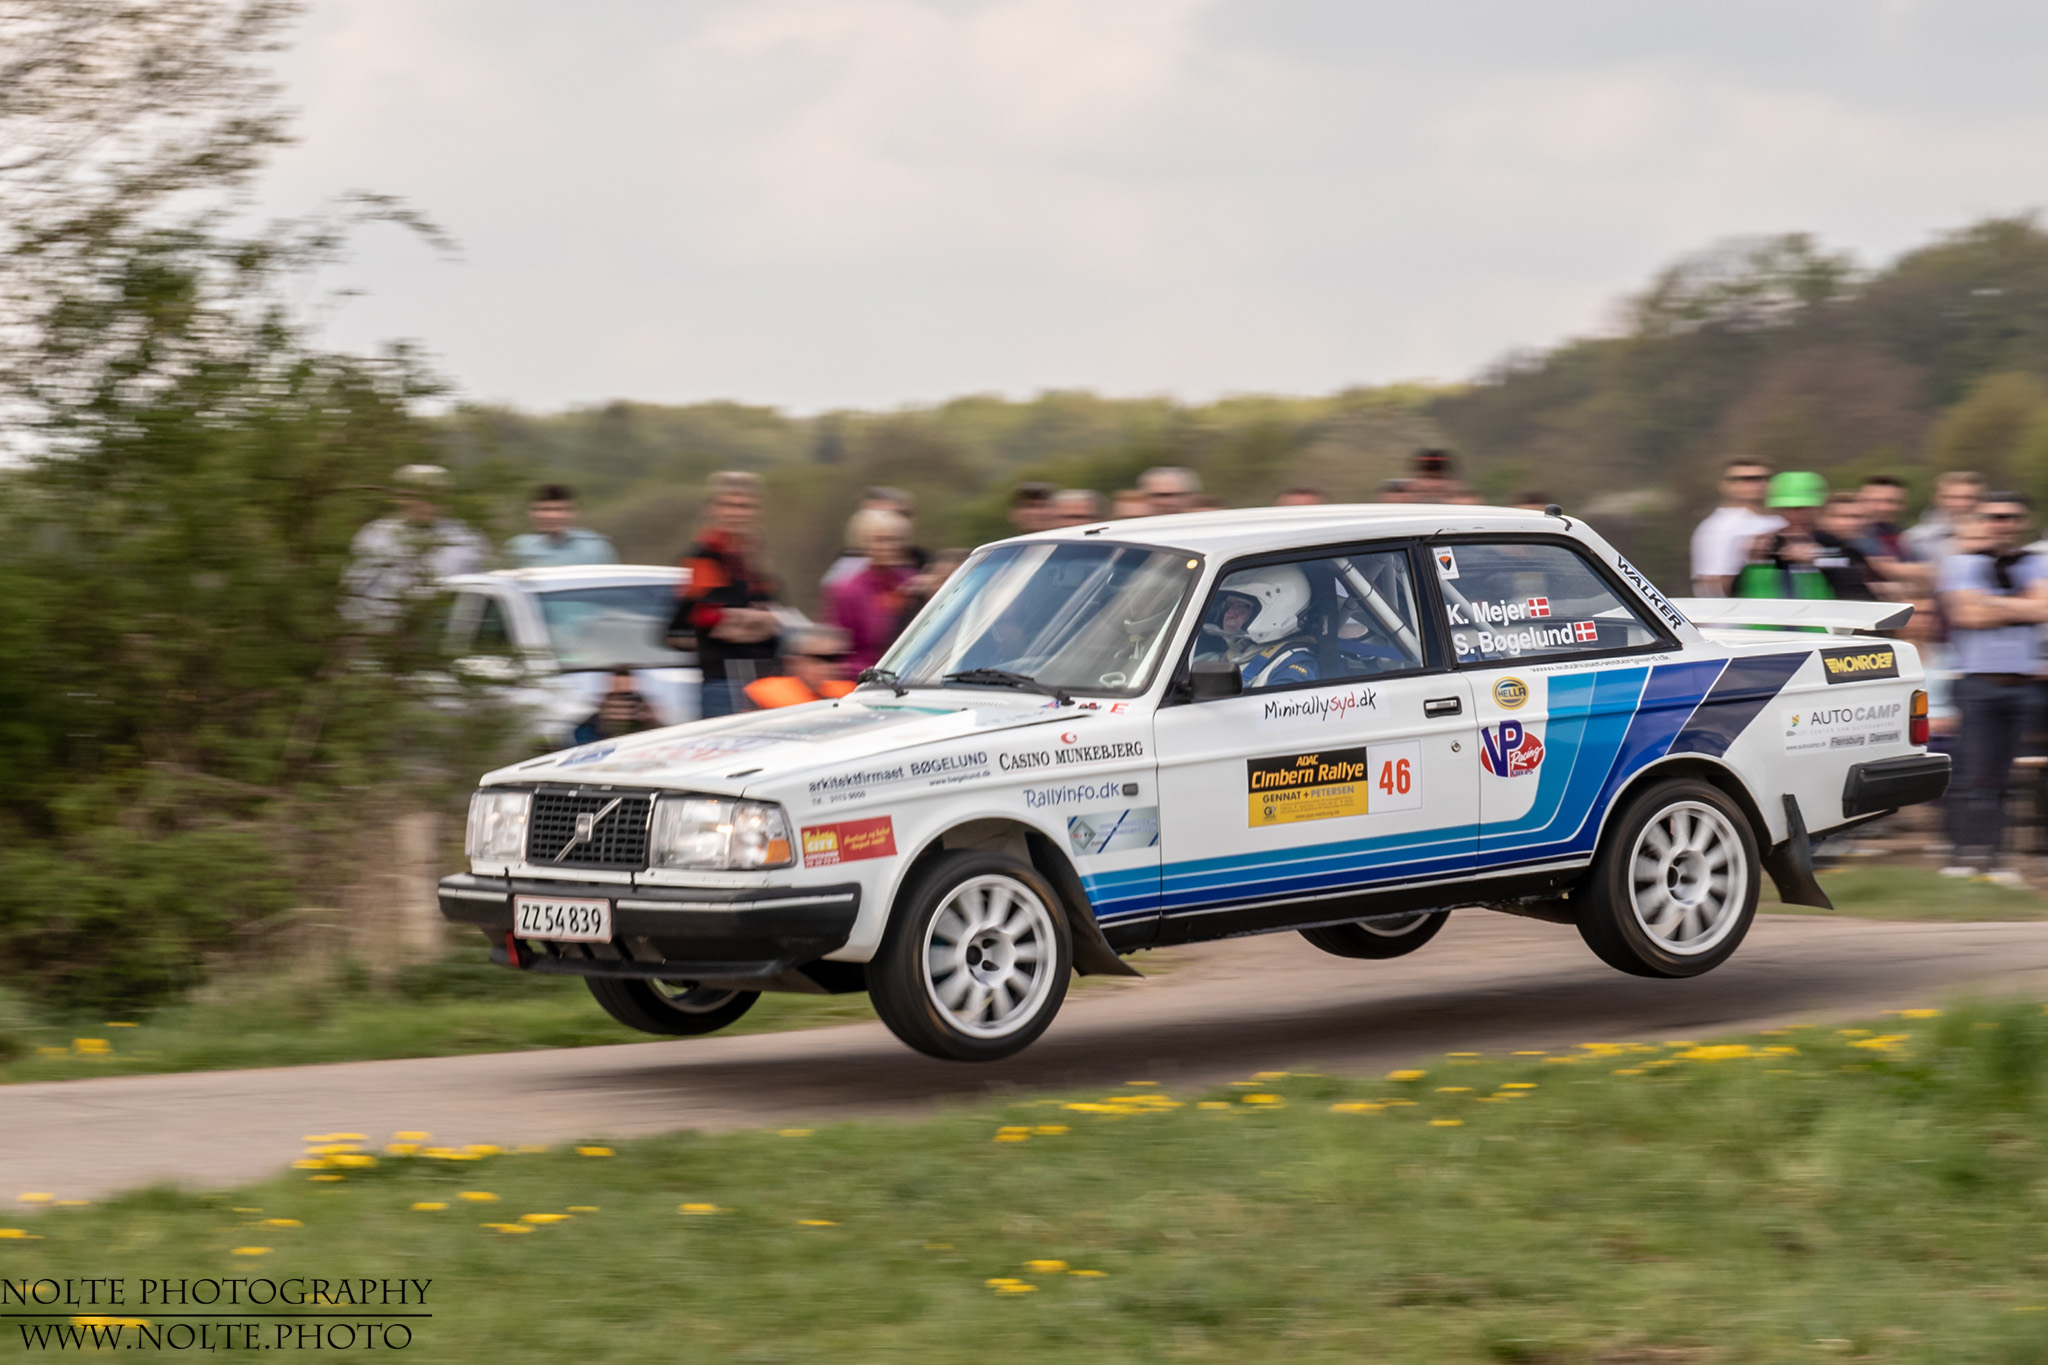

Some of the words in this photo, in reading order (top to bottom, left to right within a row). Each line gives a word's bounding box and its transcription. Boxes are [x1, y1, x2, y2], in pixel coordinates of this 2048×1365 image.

[1617, 555, 1682, 630] WALKER
[1446, 603, 1468, 625] K.
[1472, 600, 1527, 626] Mejer
[1454, 633, 1475, 655] S.
[1478, 623, 1574, 655] Bøgelund
[1826, 652, 1893, 673] MONROE
[1265, 688, 1377, 721] Minirallysyd.dk
[1498, 687, 1526, 697] HELLA
[1481, 719, 1524, 777] VP
[1831, 736, 1865, 747] Flensburg
[910, 751, 988, 776] BØGELUND
[999, 750, 1050, 771] CASINO
[1055, 741, 1144, 765] MUNKEBJERG
[1296, 754, 1319, 767] ADAC
[1511, 745, 1543, 770] Racing
[1251, 767, 1314, 789] Cimbern
[1318, 761, 1364, 782] Rallye
[1379, 758, 1411, 795] 46
[1023, 782, 1120, 808] Rallyinfo.dk
[1263, 791, 1301, 804] GENNAT
[1311, 785, 1355, 798] PETERSEN
